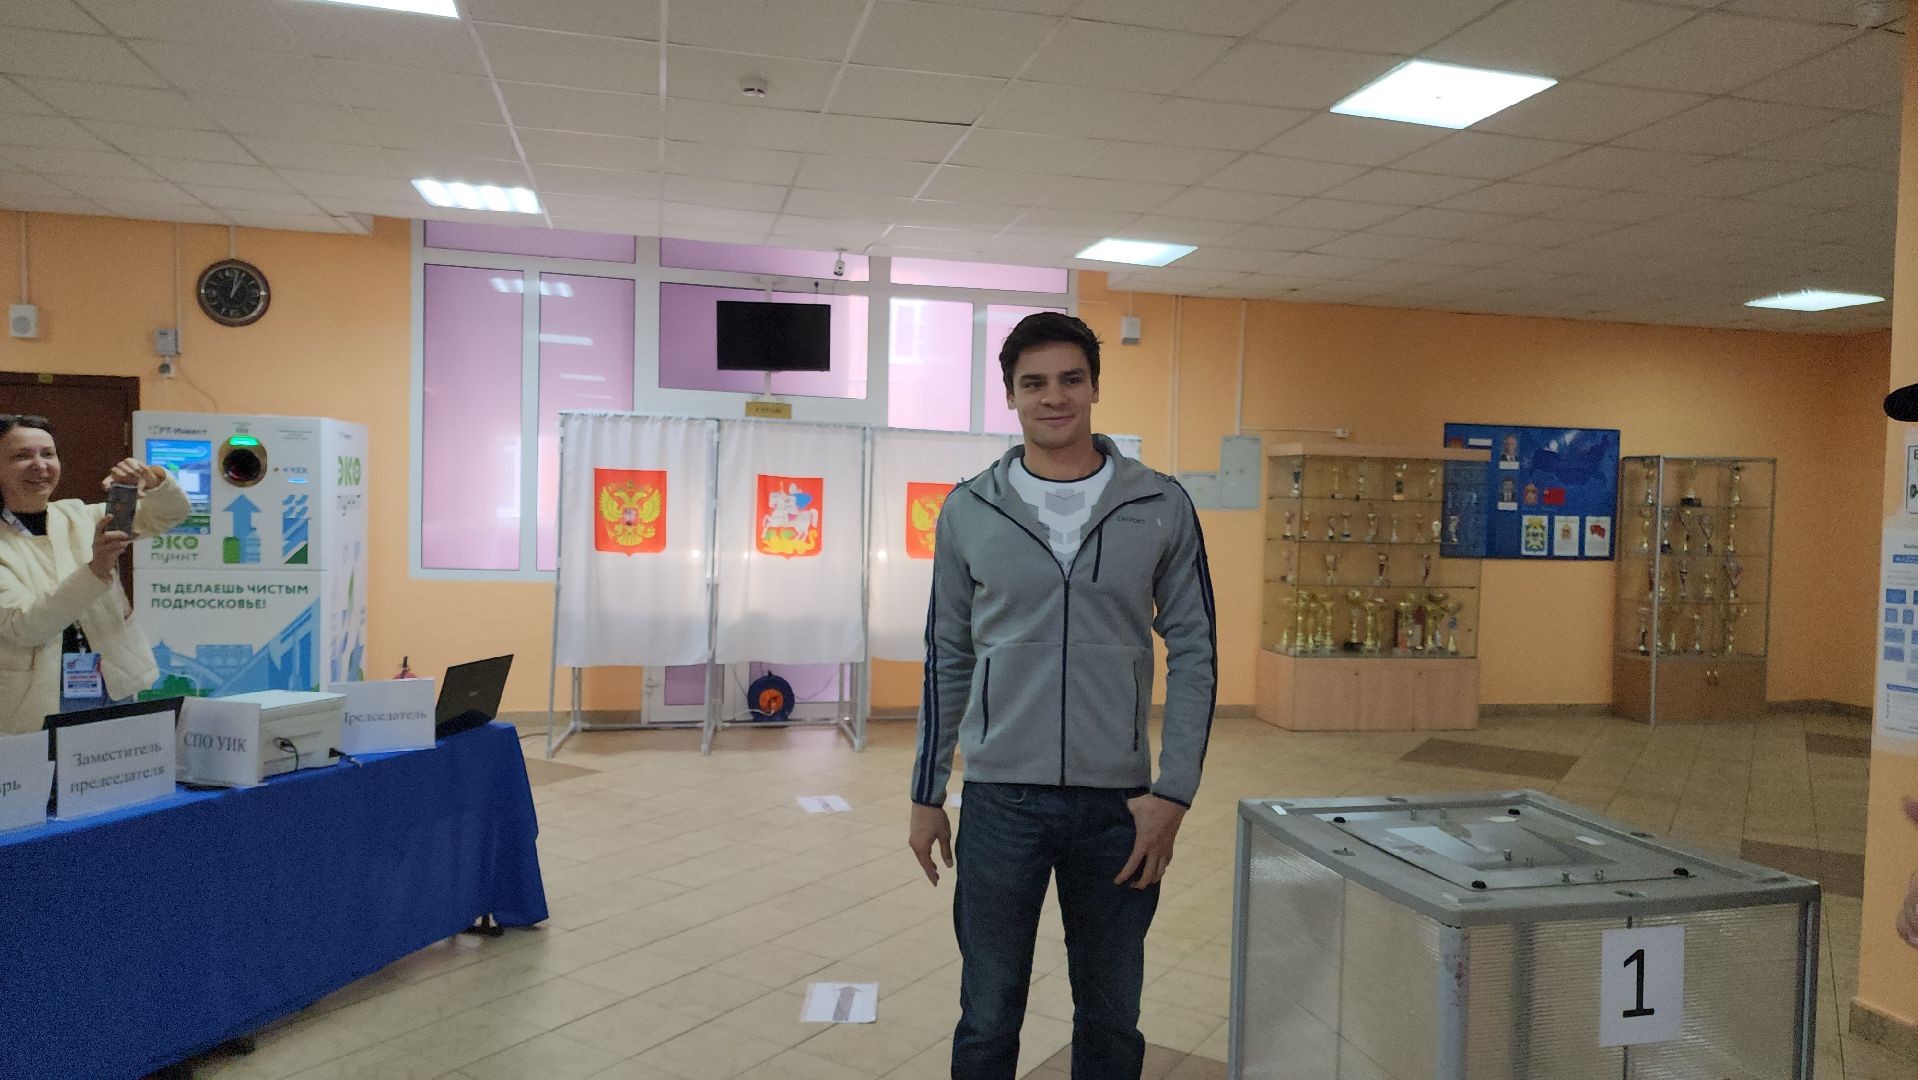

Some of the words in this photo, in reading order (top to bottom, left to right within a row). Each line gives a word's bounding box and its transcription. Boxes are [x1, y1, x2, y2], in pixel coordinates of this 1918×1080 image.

[338, 456, 361, 486] ЭКО
[151, 535, 199, 550] ЭКО
[151, 583, 171, 593] ТЫ
[175, 583, 244, 594] ДЕЛАЕШЬ
[247, 584, 309, 595] ЧИСТЫМ
[151, 598, 267, 609] ПОДМОСКОВЬЕ!
[183, 731, 214, 750] СПО
[218, 735, 247, 753] УИК
[72, 742, 162, 767] Заместитель
[70, 764, 165, 795] председателя
[1622, 949, 1655, 1018] 1
